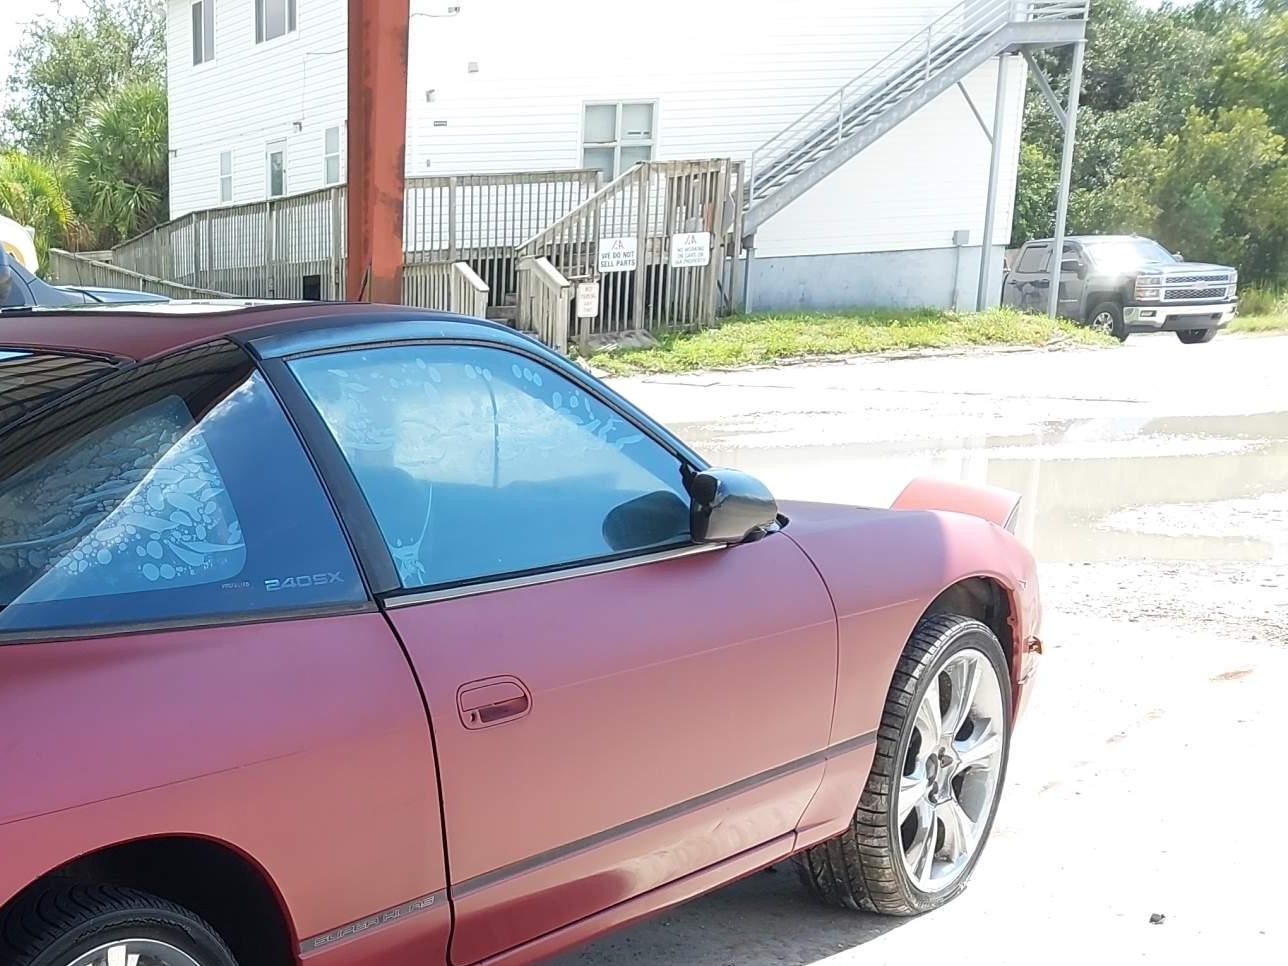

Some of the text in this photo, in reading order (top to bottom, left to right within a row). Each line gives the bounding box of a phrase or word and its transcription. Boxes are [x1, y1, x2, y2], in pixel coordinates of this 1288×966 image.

[623, 250, 634, 258] NOT
[616, 259, 636, 267] PARTS
[264, 571, 344, 591] 240SX
